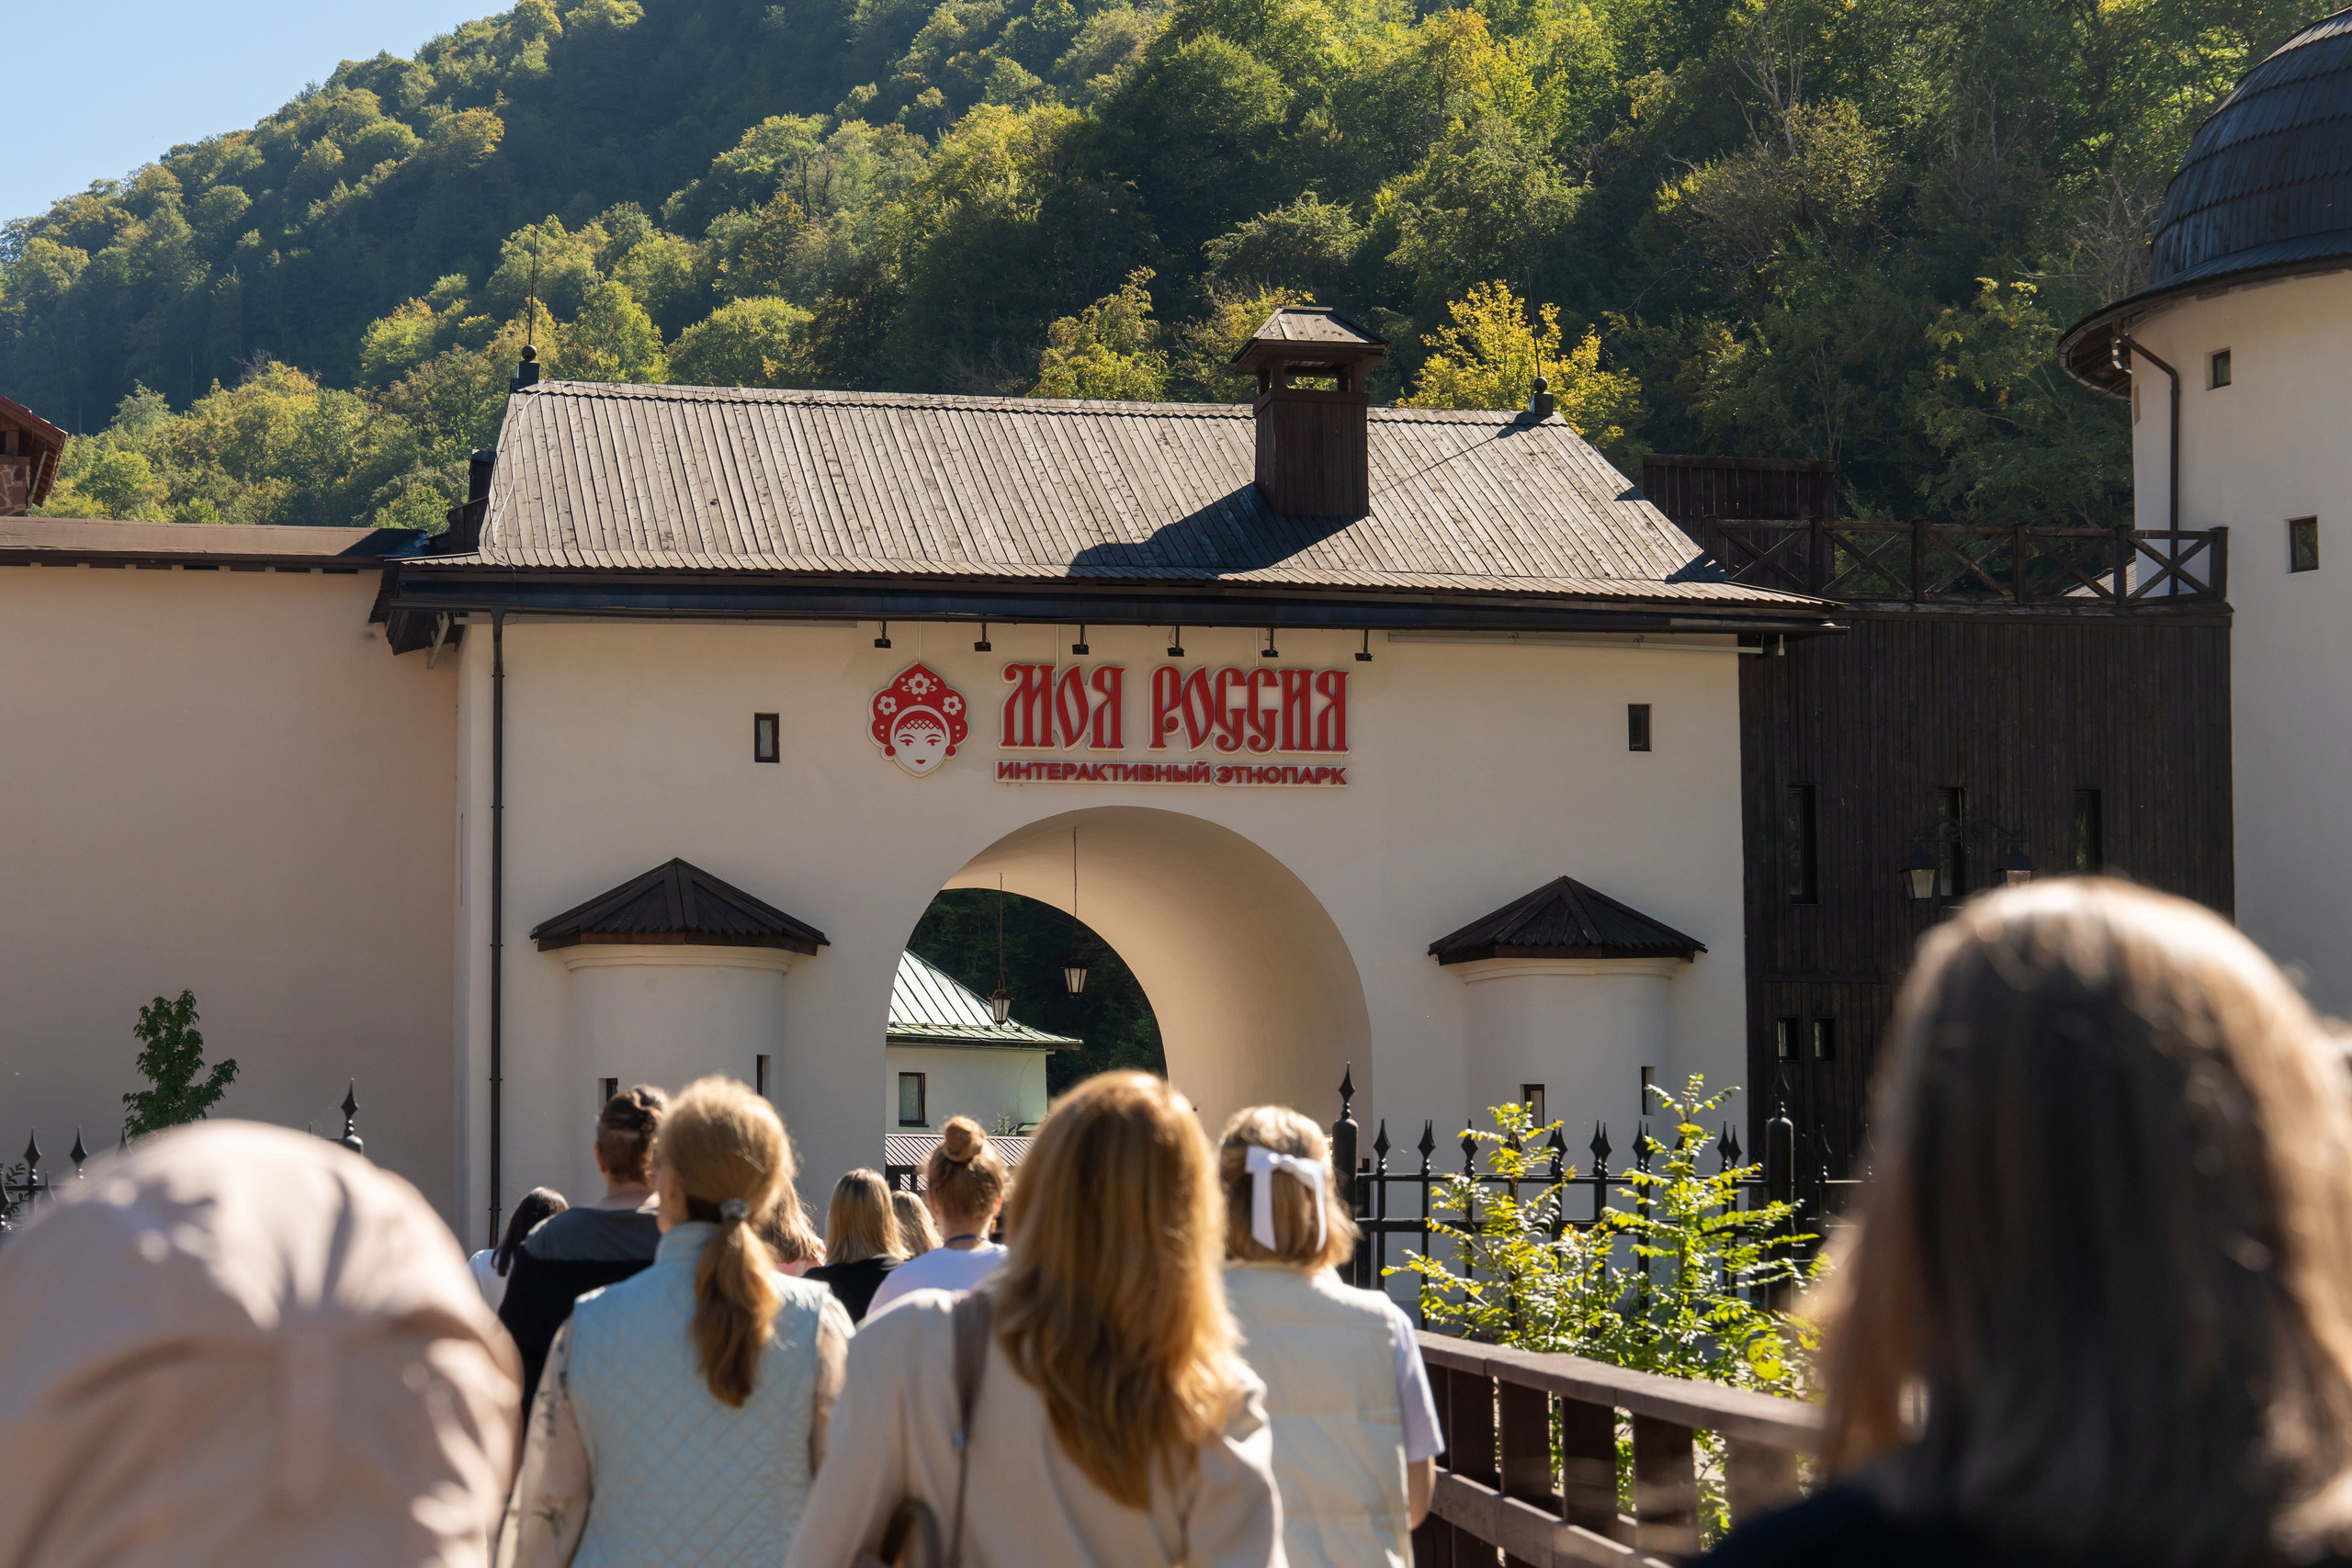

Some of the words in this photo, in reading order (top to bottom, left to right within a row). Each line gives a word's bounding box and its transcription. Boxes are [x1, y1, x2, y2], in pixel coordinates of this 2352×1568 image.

[1001, 663, 1125, 749] МОЯ
[1150, 666, 1349, 752] РОССИЯ
[998, 761, 1210, 784] ИНТЕРАКТИВНЫЙ
[1216, 766, 1348, 784] ЭТНОПАРК
